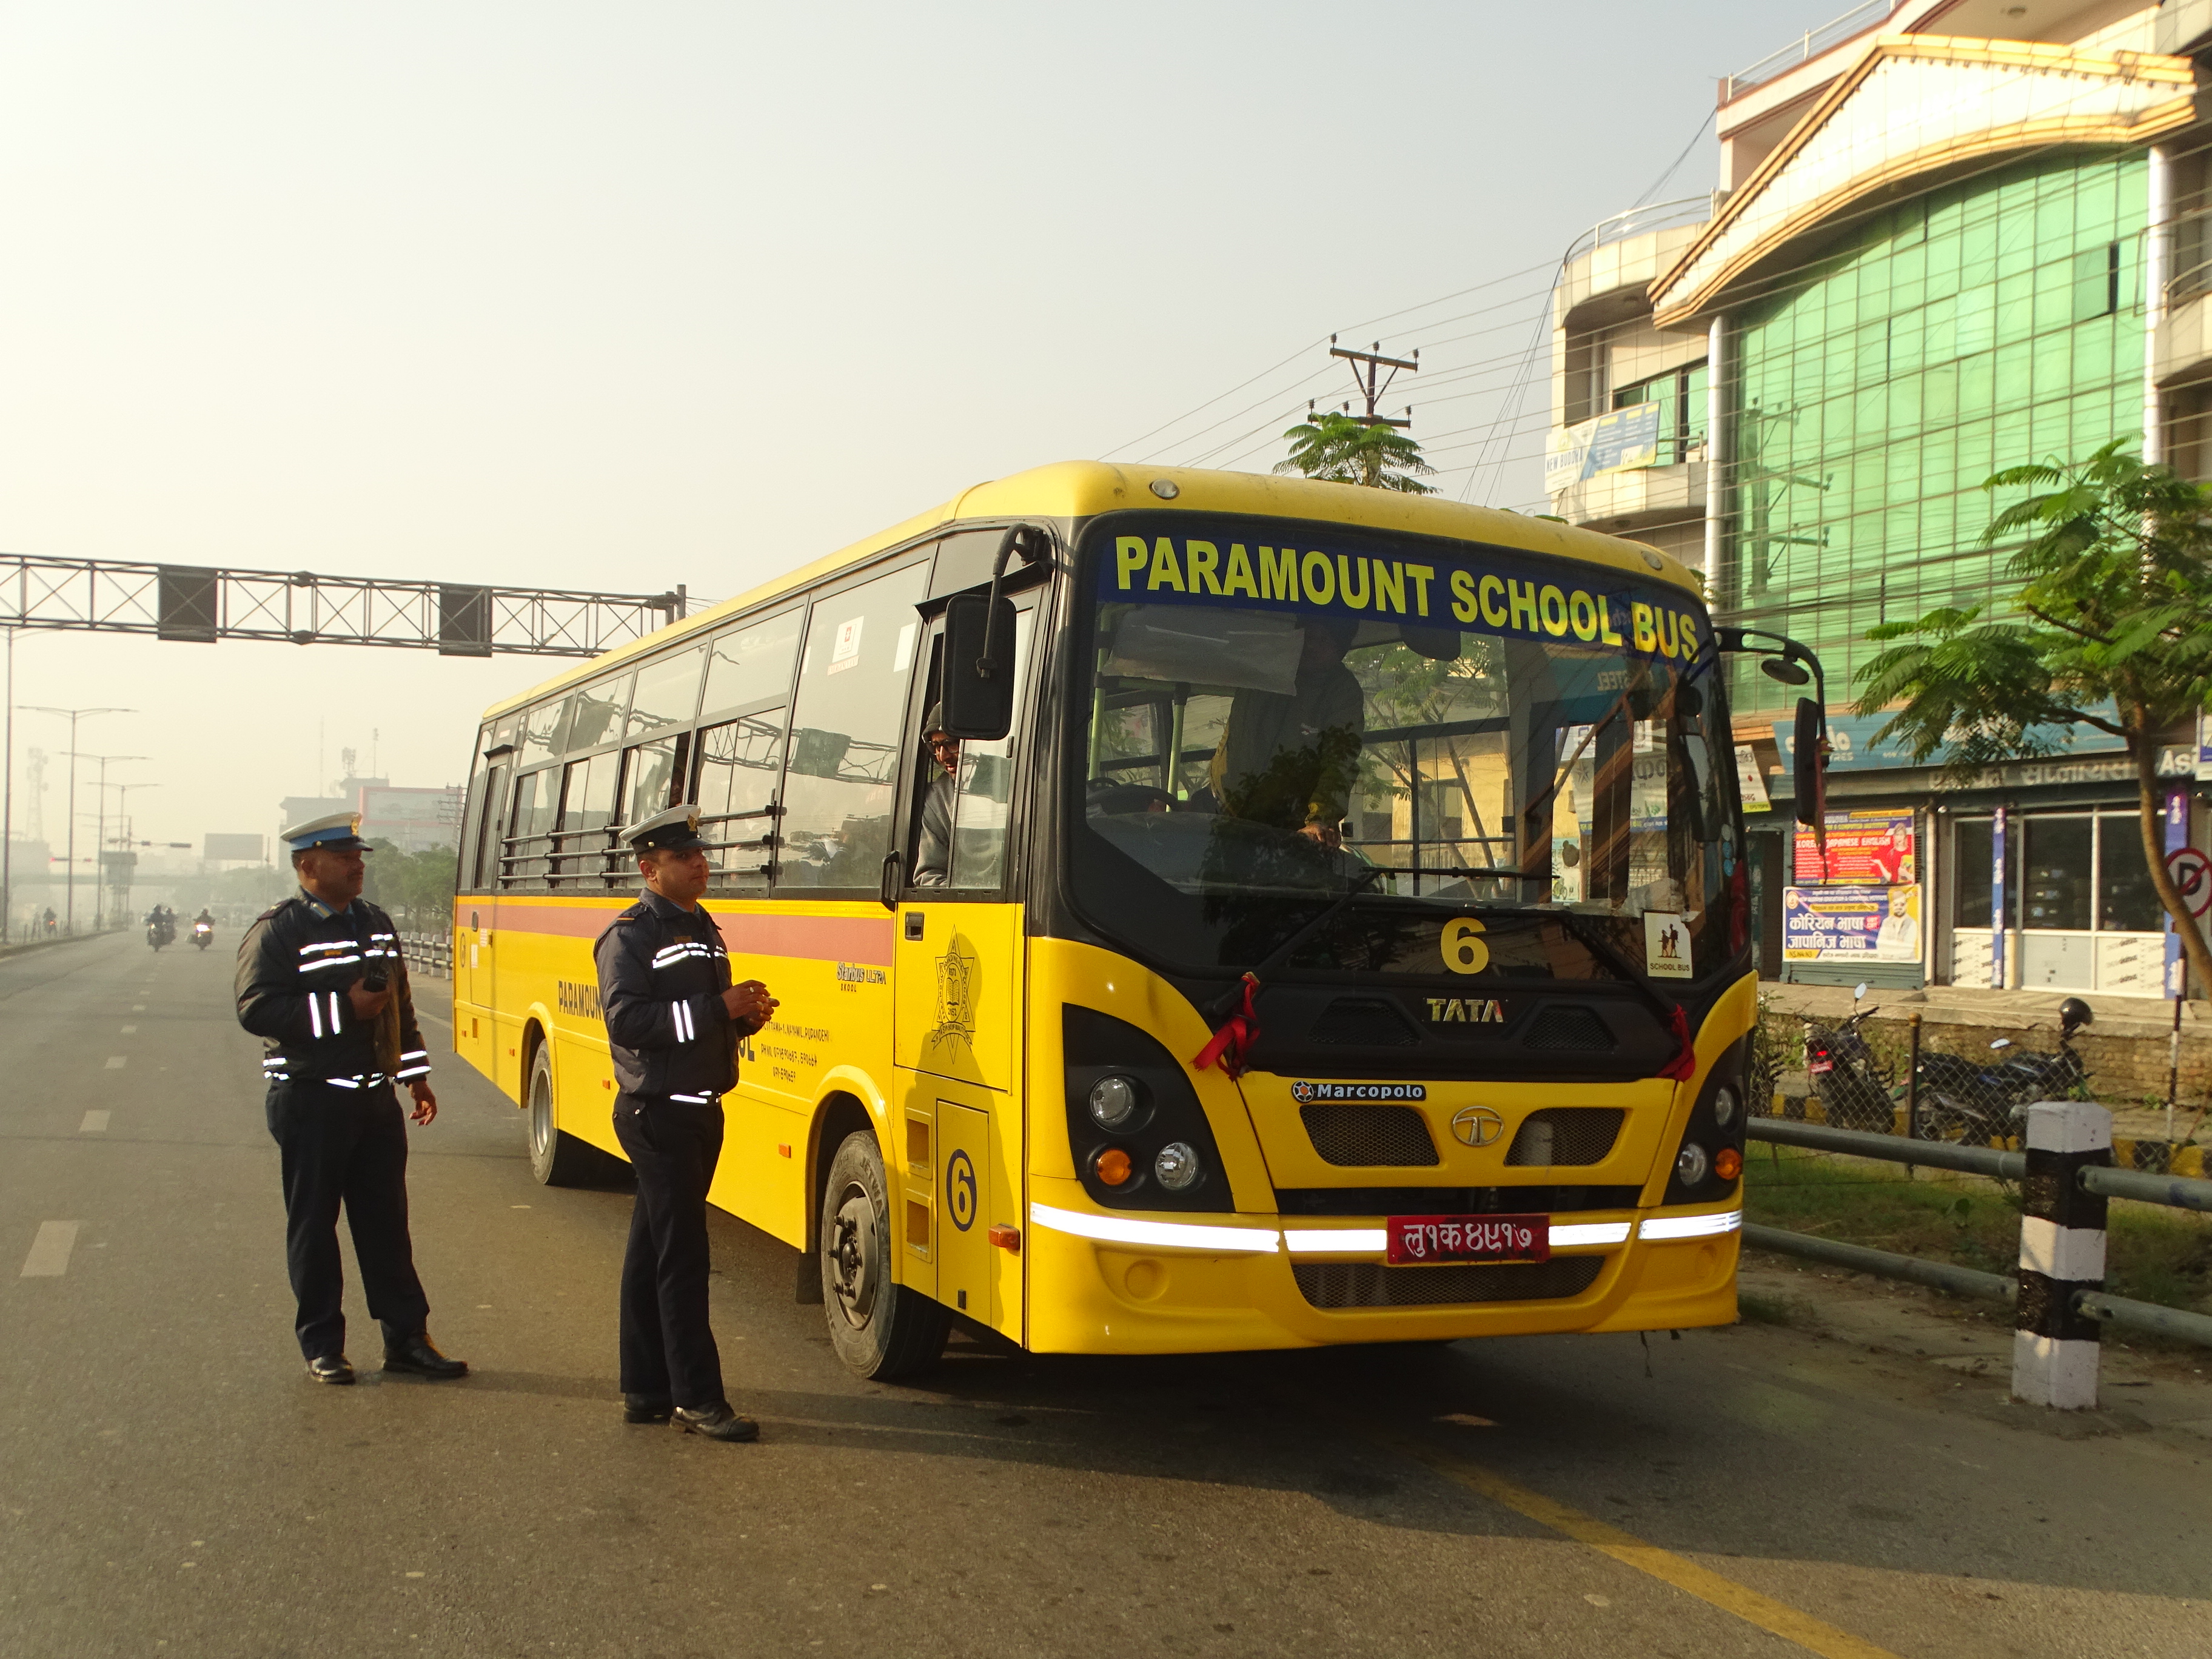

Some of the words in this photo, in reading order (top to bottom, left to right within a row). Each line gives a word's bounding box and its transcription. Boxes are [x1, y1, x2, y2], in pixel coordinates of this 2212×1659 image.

[1116, 537, 1434, 617] PARAMOUNT
[1450, 570, 1623, 647] SCHOOL
[1631, 602, 1699, 665] BUS
[1789, 913, 1835, 931] कोरियन
[1837, 916, 1865, 930] भाषा
[1440, 917, 1489, 974] 6
[1839, 935, 1866, 948] भाषा
[837, 962, 865, 982] Starbus
[840, 984, 857, 993] SKOOL
[558, 980, 602, 1022] PARAMOUN
[1426, 998, 1504, 1023] TATA
[1317, 1084, 1423, 1099] Marcopolo
[951, 1156, 972, 1225] 6
